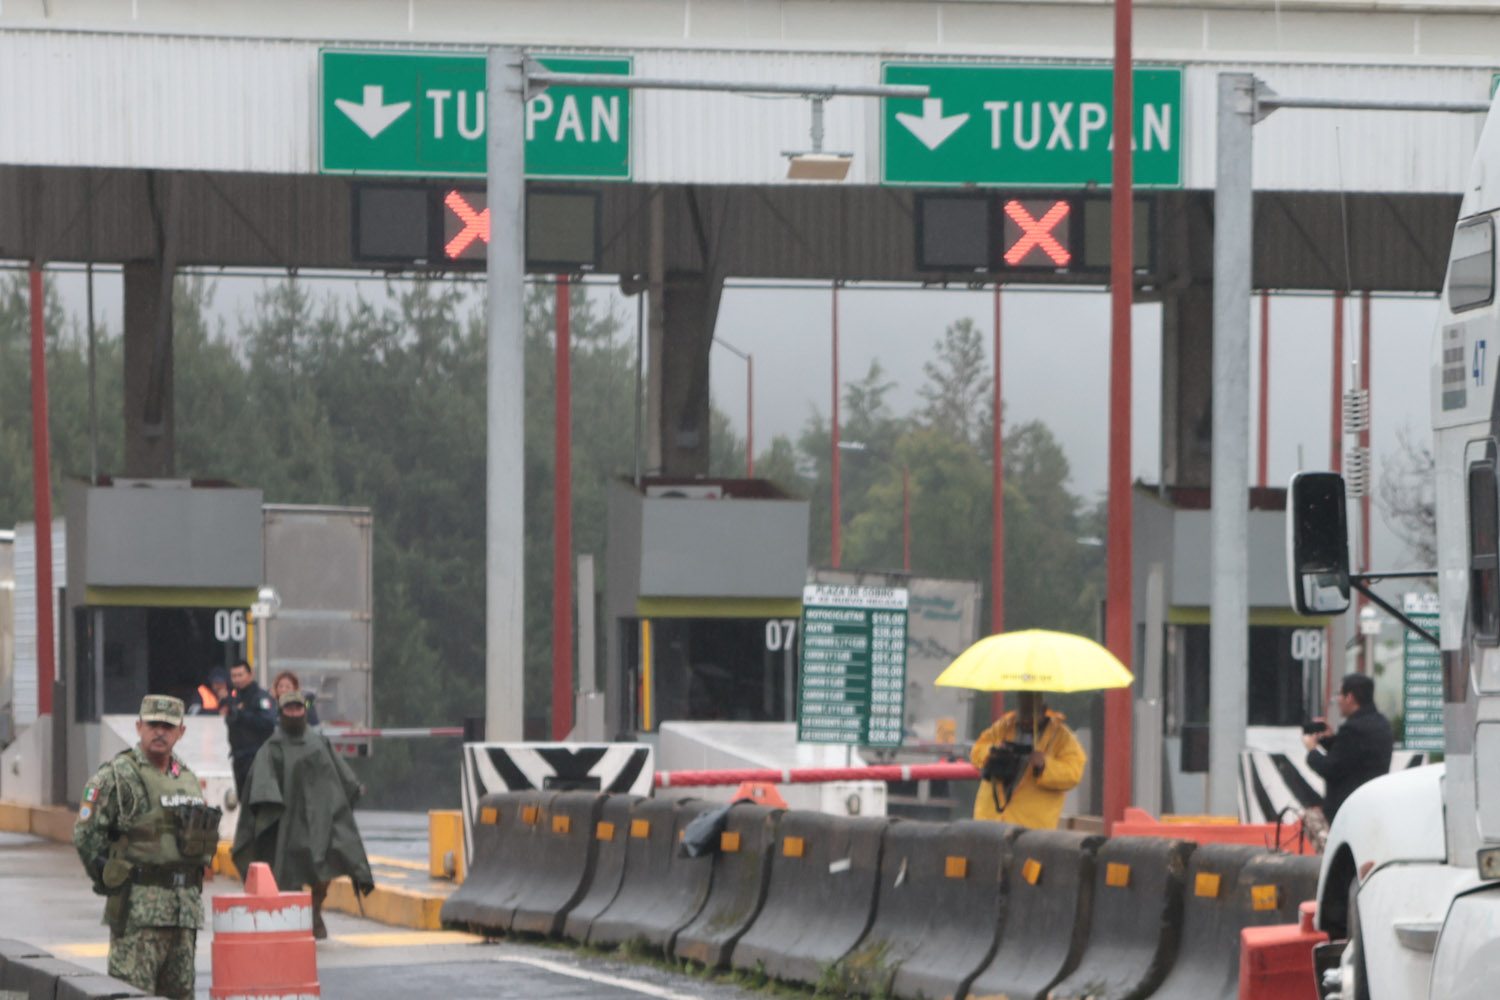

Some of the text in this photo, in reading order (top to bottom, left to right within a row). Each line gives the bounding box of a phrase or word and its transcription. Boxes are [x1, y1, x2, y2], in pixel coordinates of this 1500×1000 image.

[426, 89, 619, 143] TUPAN
[215, 609, 246, 642] 06
[806, 610, 866, 621] MOTOCICLETAS
[806, 623, 834, 634] AUTOS
[766, 619, 796, 651] 07
[1291, 629, 1321, 661] 08
